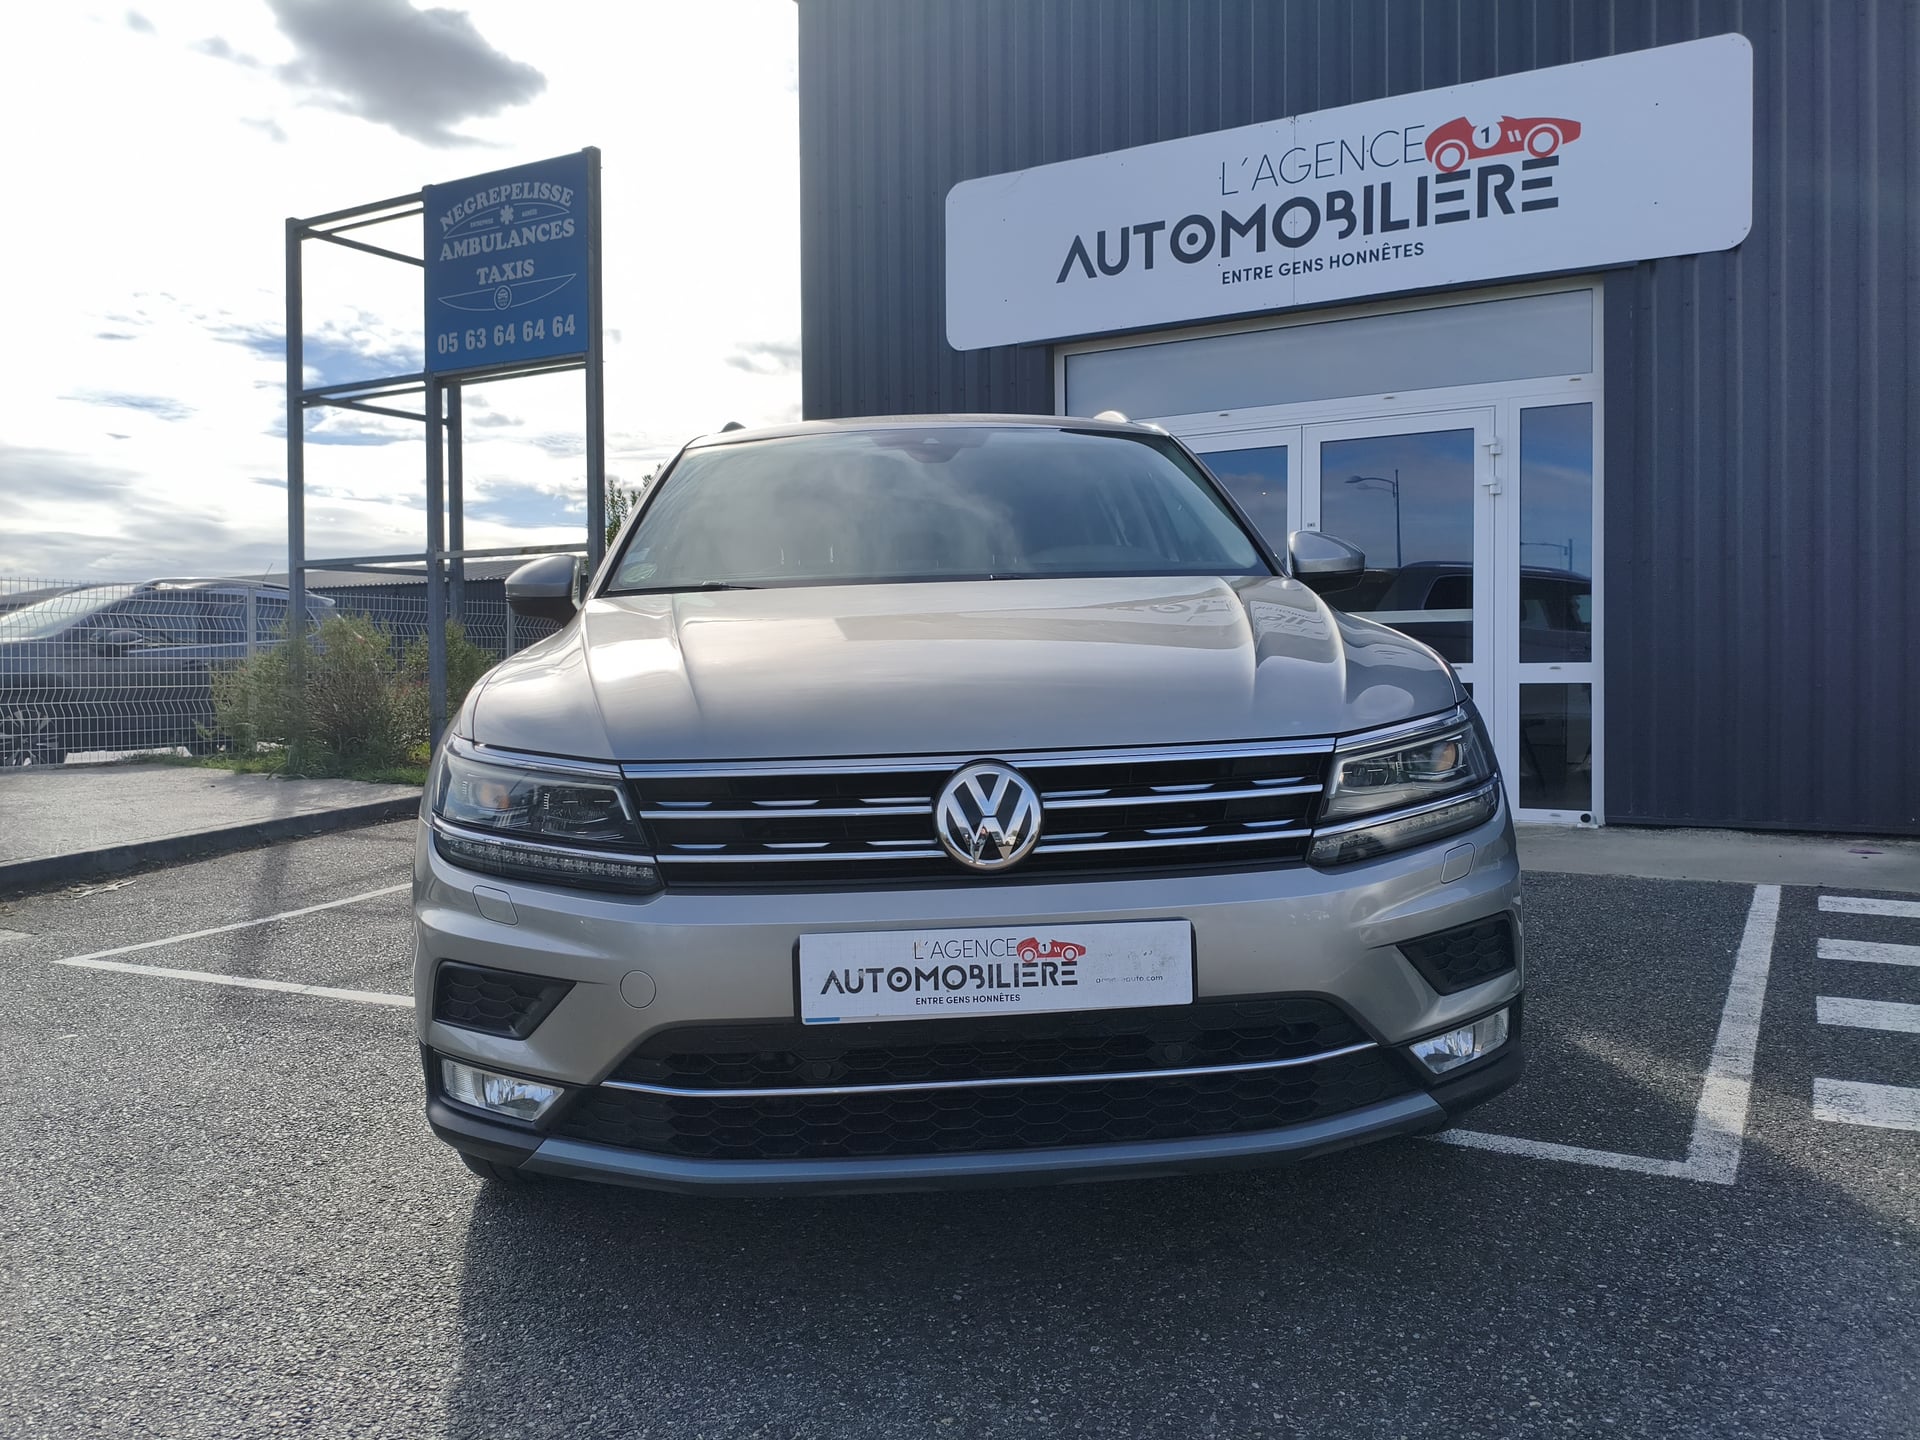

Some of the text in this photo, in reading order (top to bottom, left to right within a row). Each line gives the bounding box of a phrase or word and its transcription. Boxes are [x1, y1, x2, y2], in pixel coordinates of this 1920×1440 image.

[1481, 126, 1490, 143] 1
[1220, 125, 1426, 196] L'AGENCE
[440, 181, 574, 232] NEGREPELISSE
[439, 218, 575, 261] AMBULANCES
[476, 258, 535, 286] TAXIS
[1221, 241, 1425, 285] ENTRE GENS HONNÊTES
[437, 313, 575, 354] 05 63 64 64 64
[913, 937, 1017, 960] L'AGENCE
[915, 992, 1021, 1006] ENTRE GENS HONNÊTES
